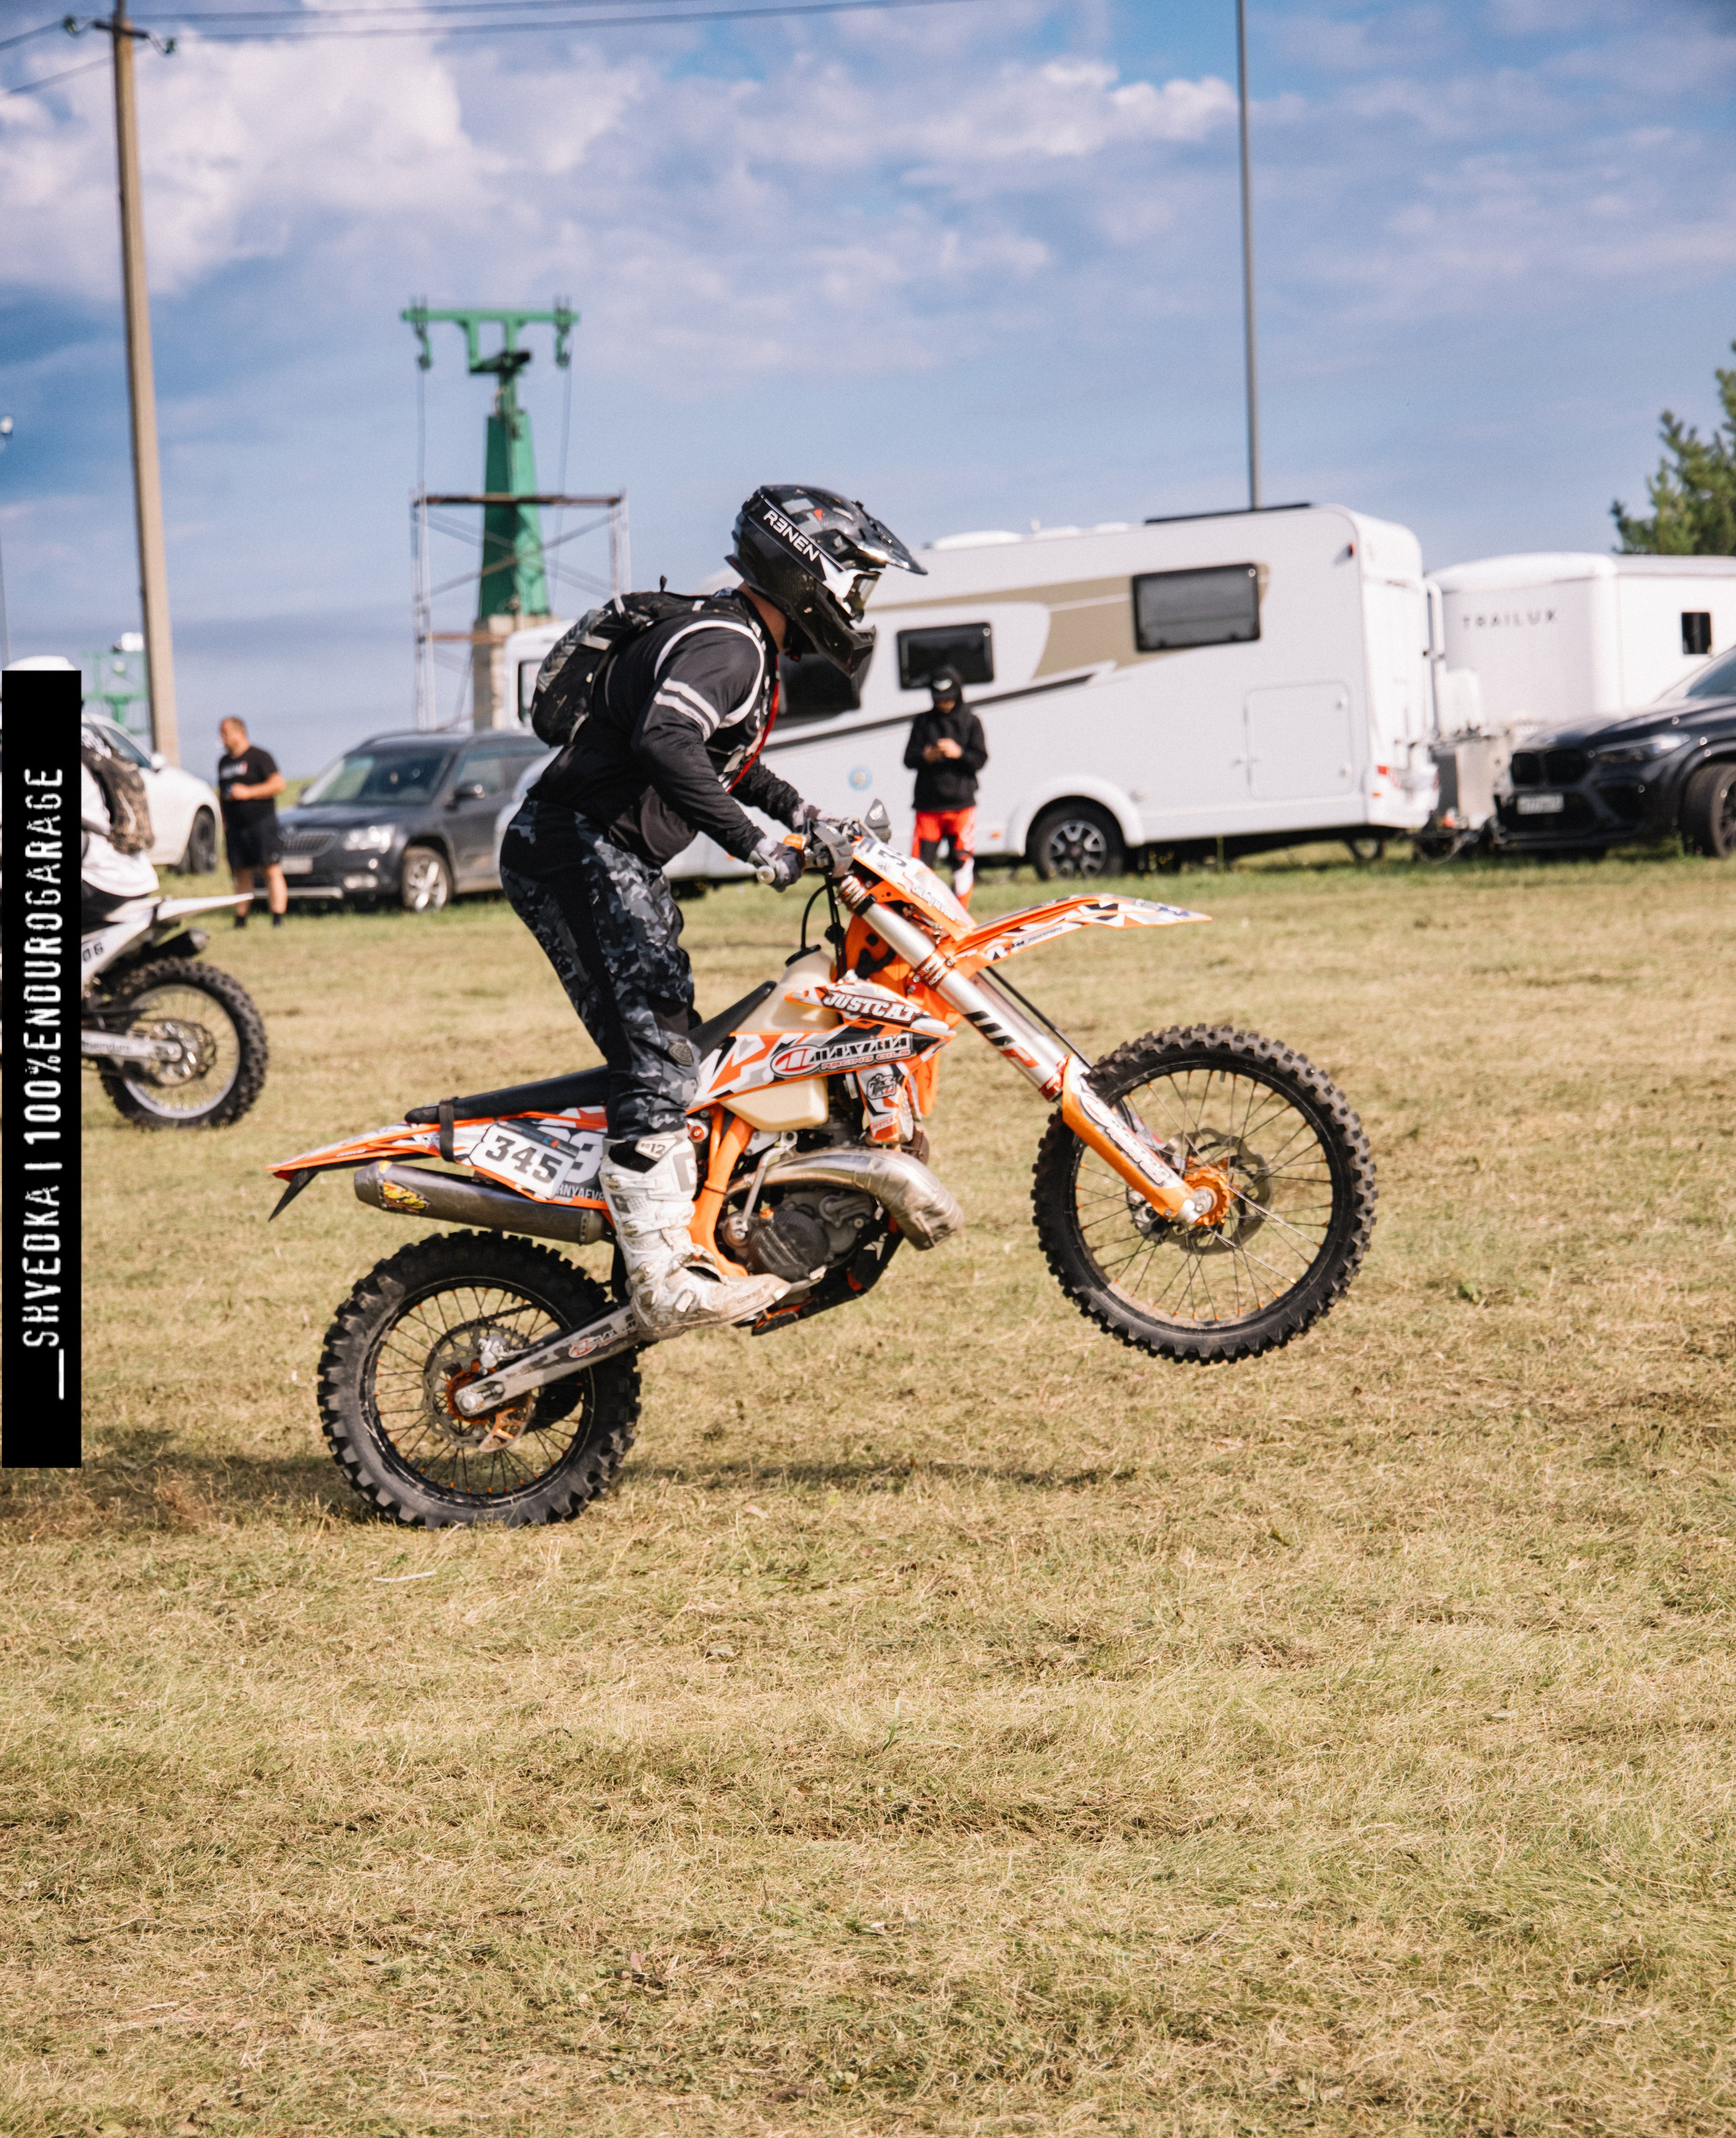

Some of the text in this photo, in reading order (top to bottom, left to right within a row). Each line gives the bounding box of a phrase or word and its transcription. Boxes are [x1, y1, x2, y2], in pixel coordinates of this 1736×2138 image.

[823, 991, 922, 1022] JUSTCAT
[821, 1050, 911, 1069] RACING OILS
[485, 1135, 564, 1184] 345
